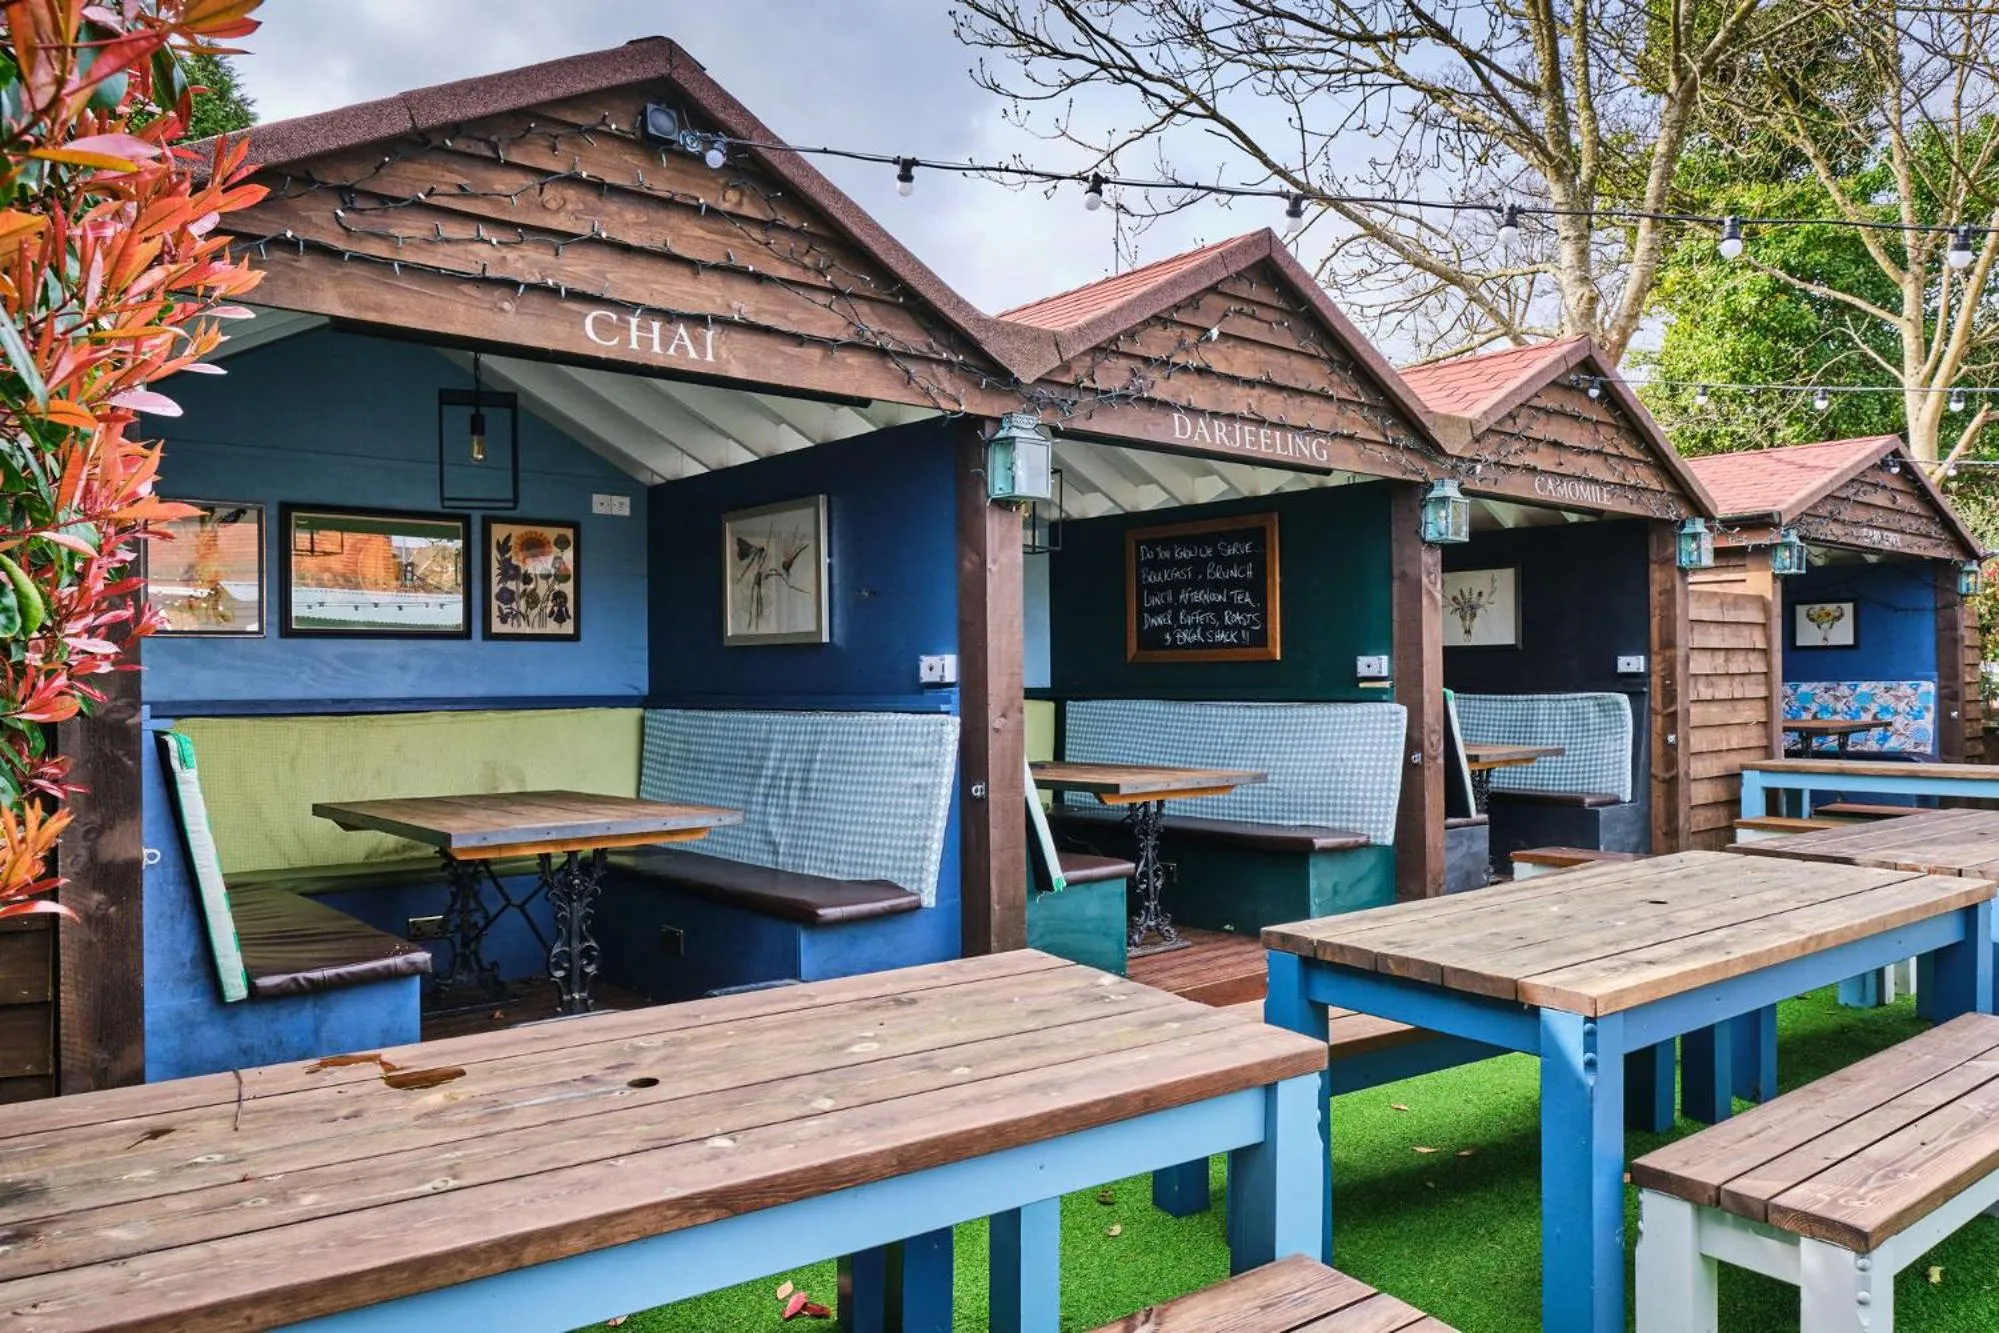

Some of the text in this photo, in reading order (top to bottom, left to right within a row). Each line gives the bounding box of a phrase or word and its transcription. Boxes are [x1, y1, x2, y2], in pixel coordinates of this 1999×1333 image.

[584, 310, 715, 362] CHAI
[1173, 412, 1328, 461] DARJEELING
[1206, 561, 1253, 580] BRUNCH
[1224, 609, 1262, 630] ROASTS
[1204, 630, 1238, 645] SHACK
